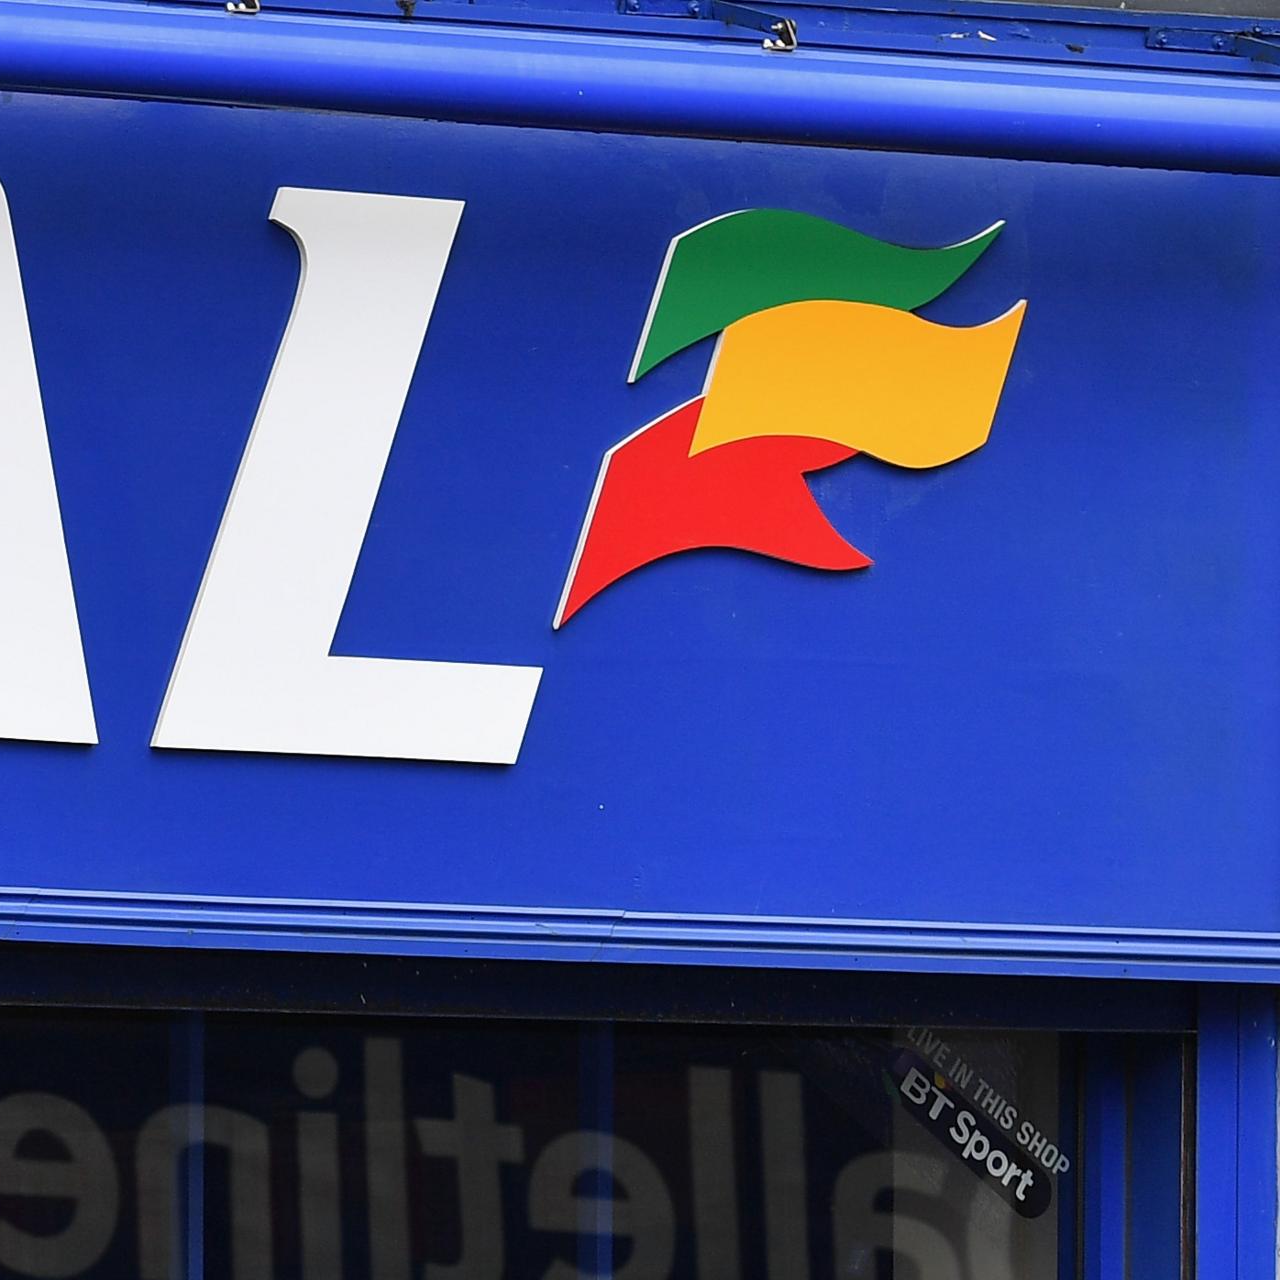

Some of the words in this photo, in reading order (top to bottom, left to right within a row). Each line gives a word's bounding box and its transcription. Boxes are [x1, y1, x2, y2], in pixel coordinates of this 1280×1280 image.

[900, 1068, 954, 1120] BT
[950, 1110, 1034, 1200] Sport
[906, 1026, 950, 1066] LIVE
[949, 1058, 973, 1089] IN
[972, 1079, 1018, 1129] THIS
[1016, 1122, 1070, 1175] SHOP
